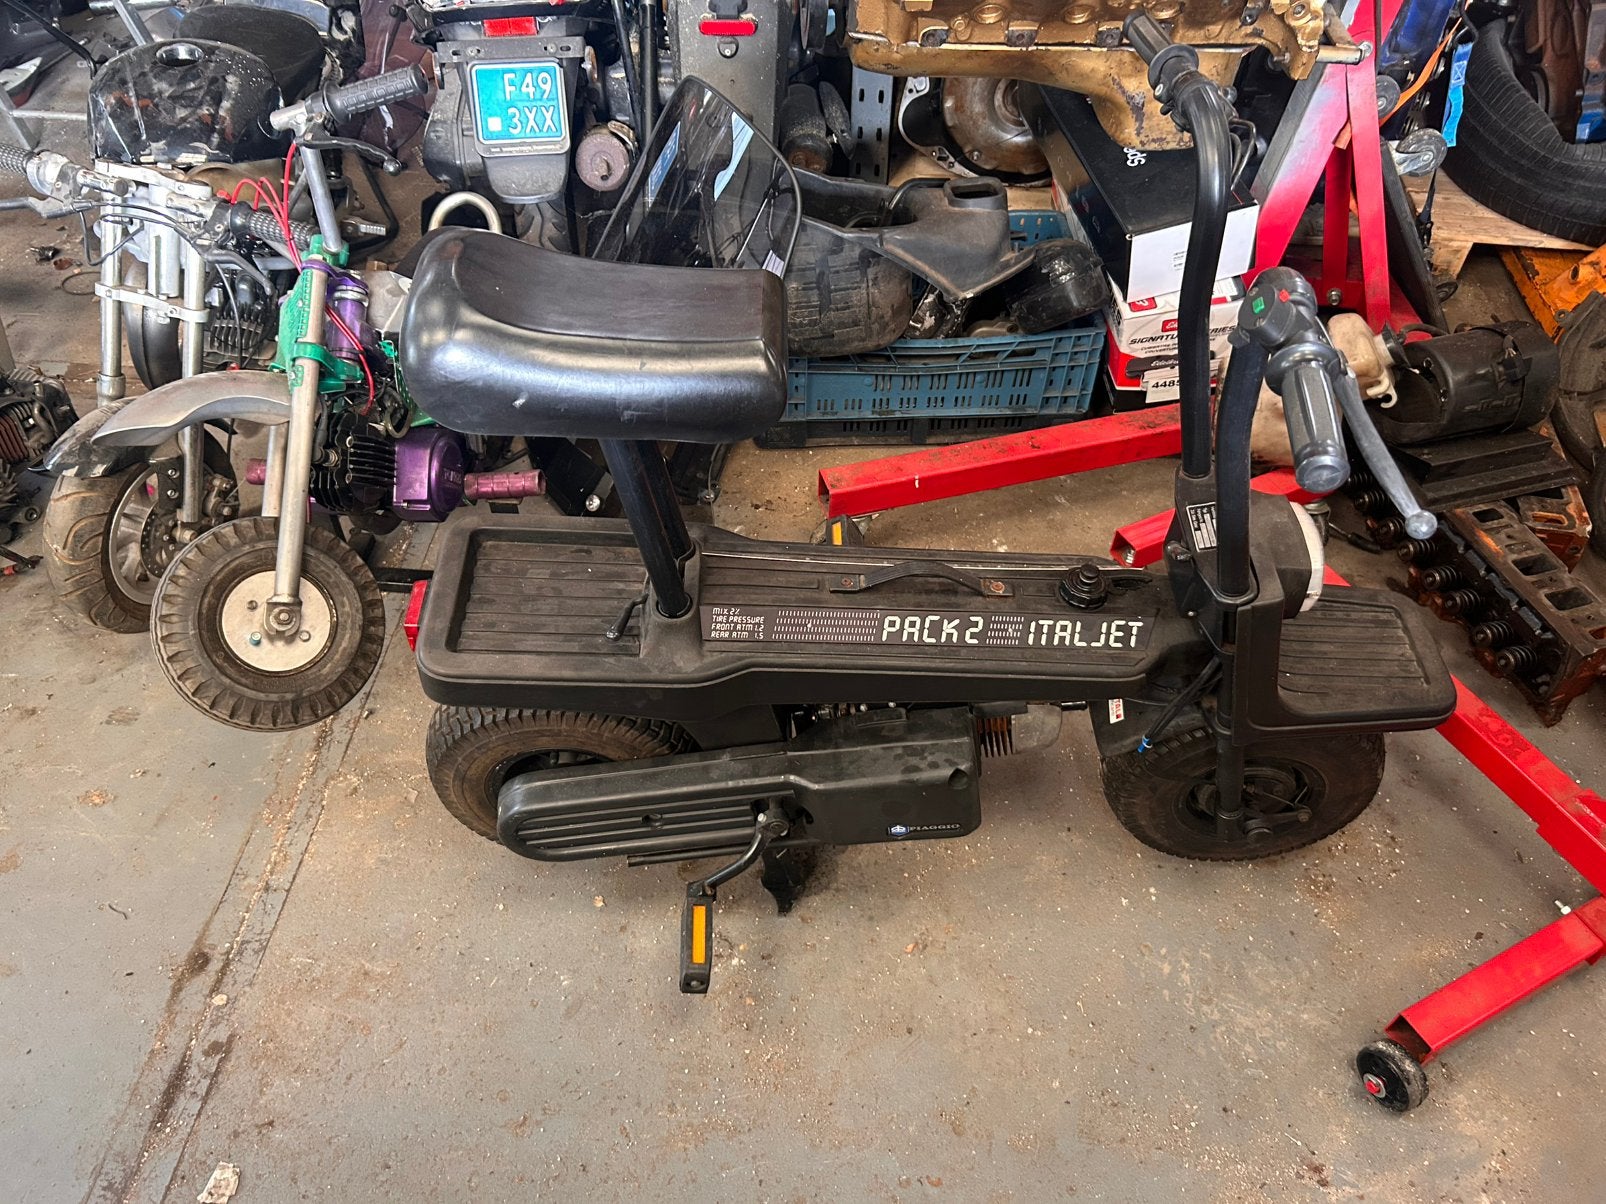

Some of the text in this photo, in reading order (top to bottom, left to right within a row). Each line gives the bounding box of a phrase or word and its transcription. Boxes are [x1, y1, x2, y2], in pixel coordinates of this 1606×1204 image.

[503, 72, 552, 101] F49
[507, 105, 557, 135] 3XX
[1123, 147, 1147, 167] Spe
[712, 607, 740, 616] MIX 2%
[712, 615, 765, 624] TIRE PRESSURE
[711, 623, 734, 631] FRONT
[882, 615, 1143, 648] PACK 2 ITALJET
[711, 631, 729, 639] REAR
[731, 631, 749, 639] ATM
[909, 823, 961, 831] PIAGGIO
